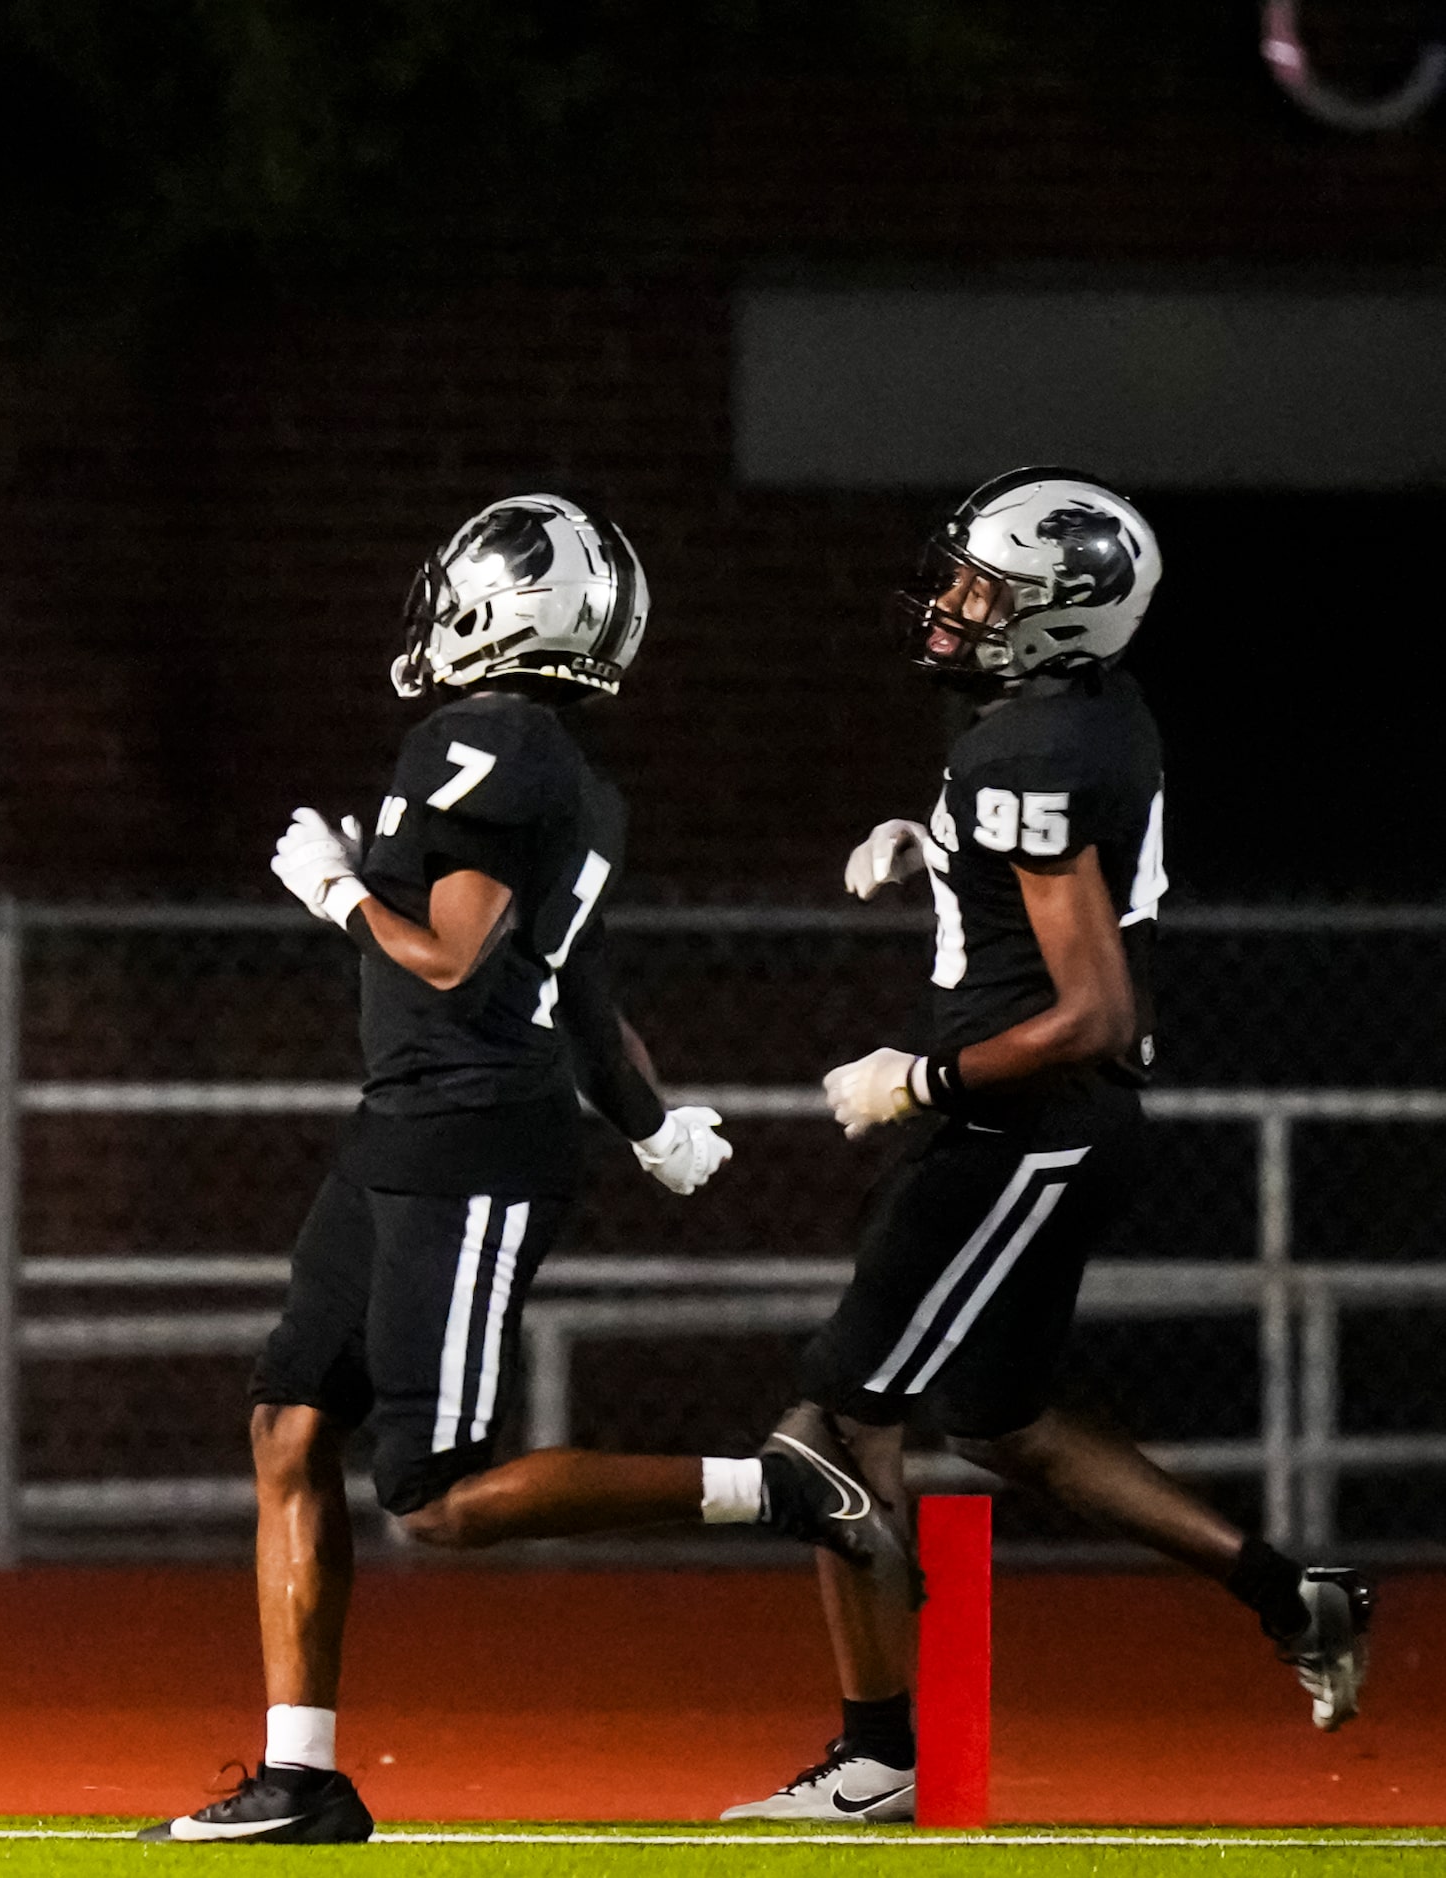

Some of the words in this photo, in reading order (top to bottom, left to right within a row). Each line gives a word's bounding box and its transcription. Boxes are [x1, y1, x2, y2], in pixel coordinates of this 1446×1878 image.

[633, 615, 642, 639] 7
[426, 741, 497, 811] 7
[973, 787, 1070, 856] 95
